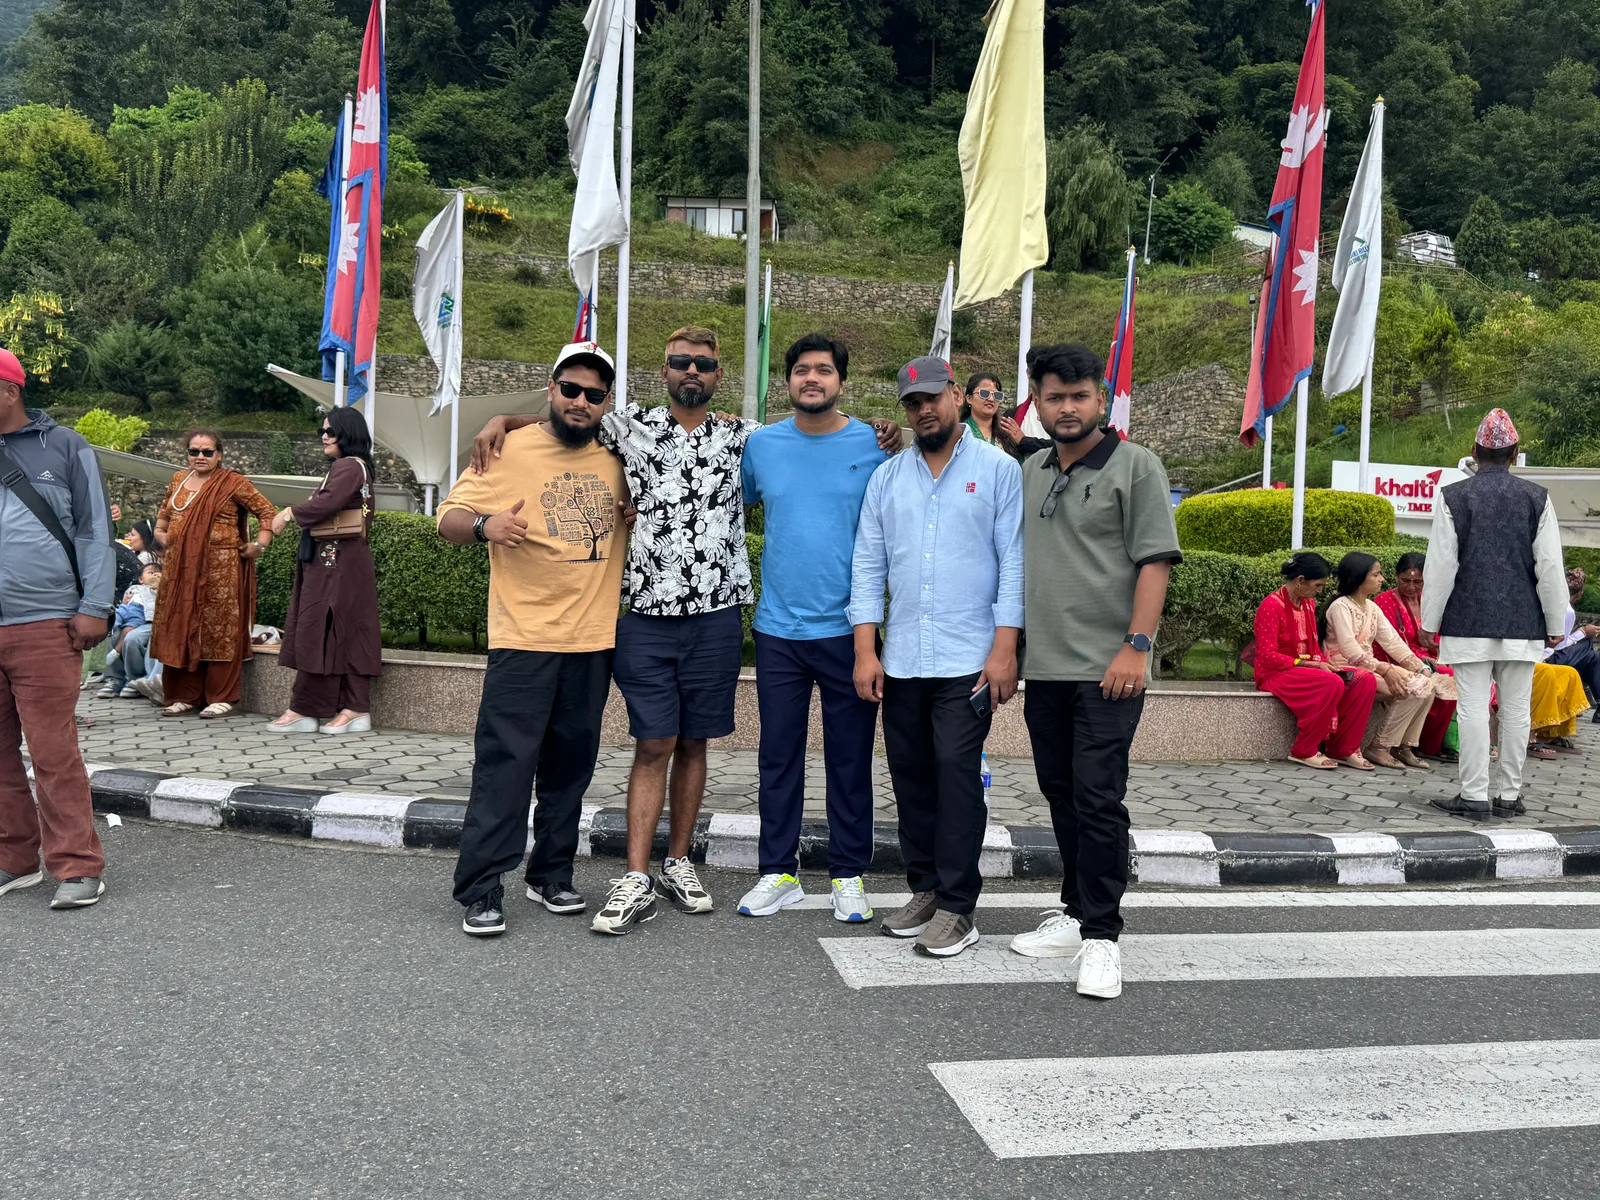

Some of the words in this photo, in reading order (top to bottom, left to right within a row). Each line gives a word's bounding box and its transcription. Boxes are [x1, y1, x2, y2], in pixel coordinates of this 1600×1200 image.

[1375, 476, 1434, 498] khalti
[1397, 504, 1407, 513] by
[1407, 502, 1432, 512] IME
